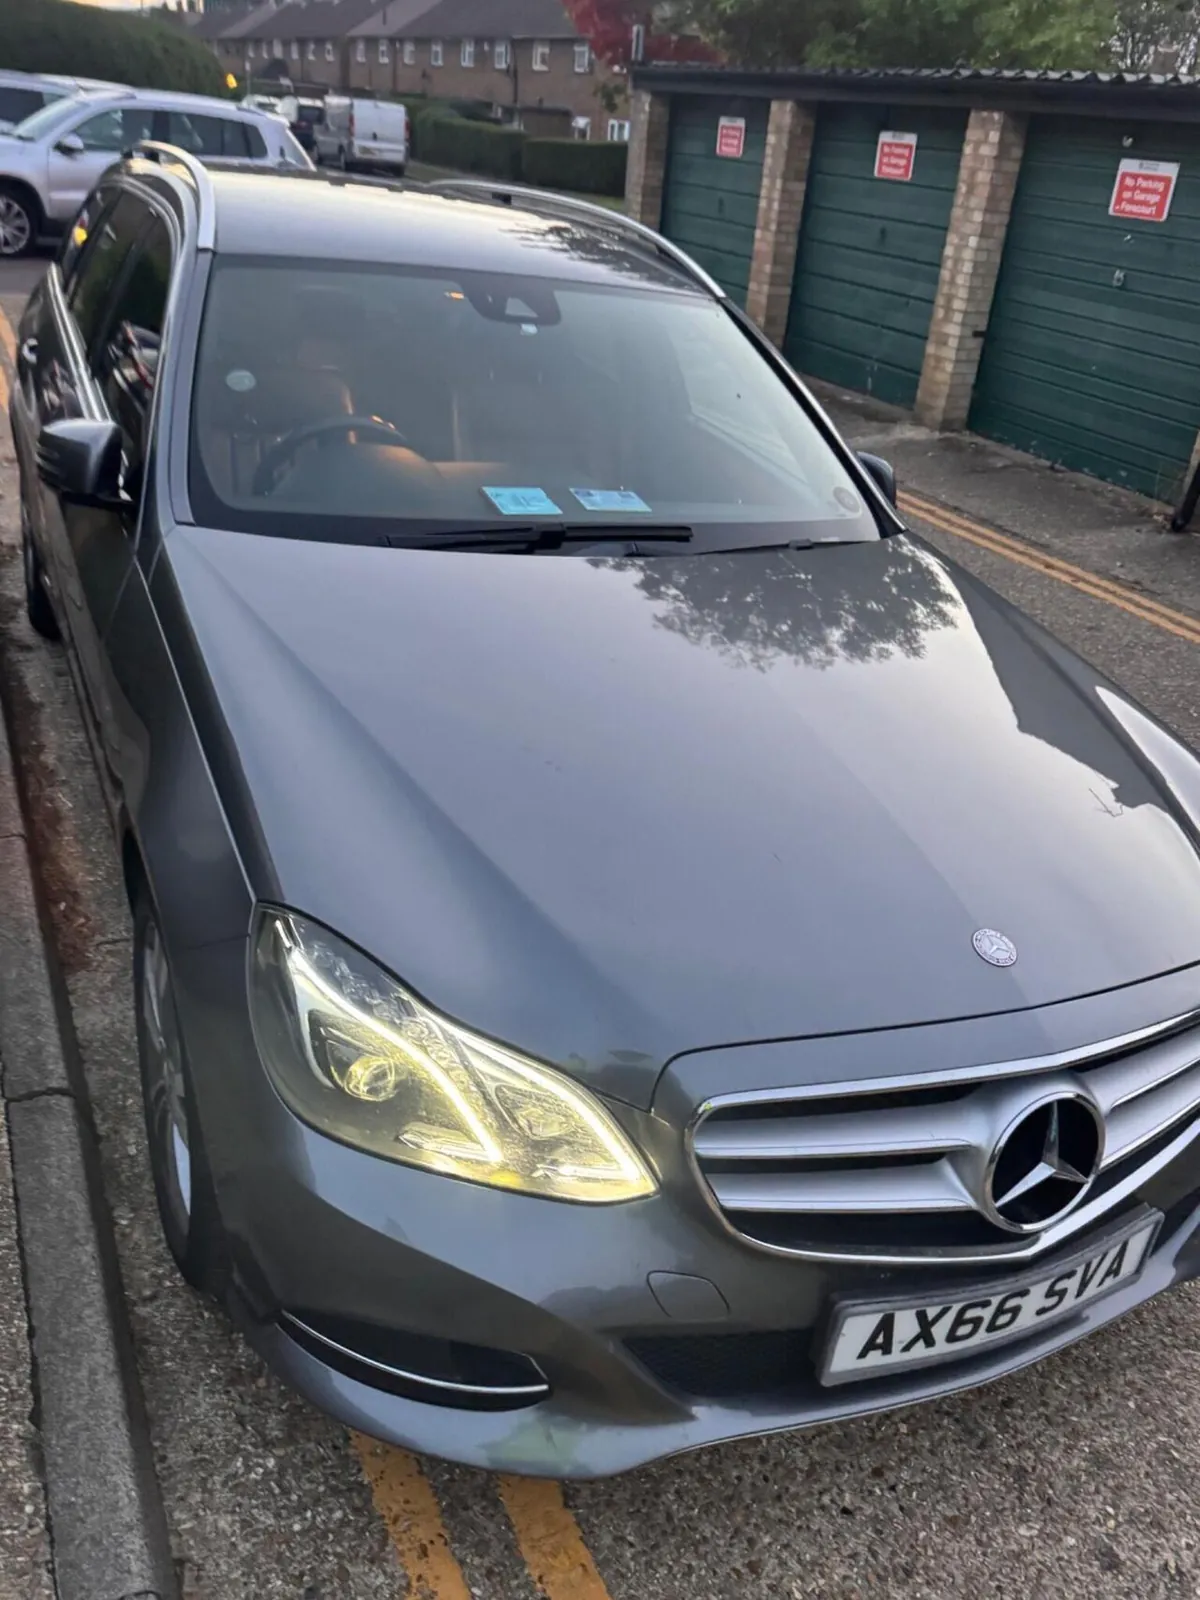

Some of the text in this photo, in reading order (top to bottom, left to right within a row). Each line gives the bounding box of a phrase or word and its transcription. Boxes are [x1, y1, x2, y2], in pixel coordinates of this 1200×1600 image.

[1124, 176, 1165, 192] No Parking
[1133, 189, 1161, 205] Garage
[857, 1239, 1130, 1360] AX66 SVA
